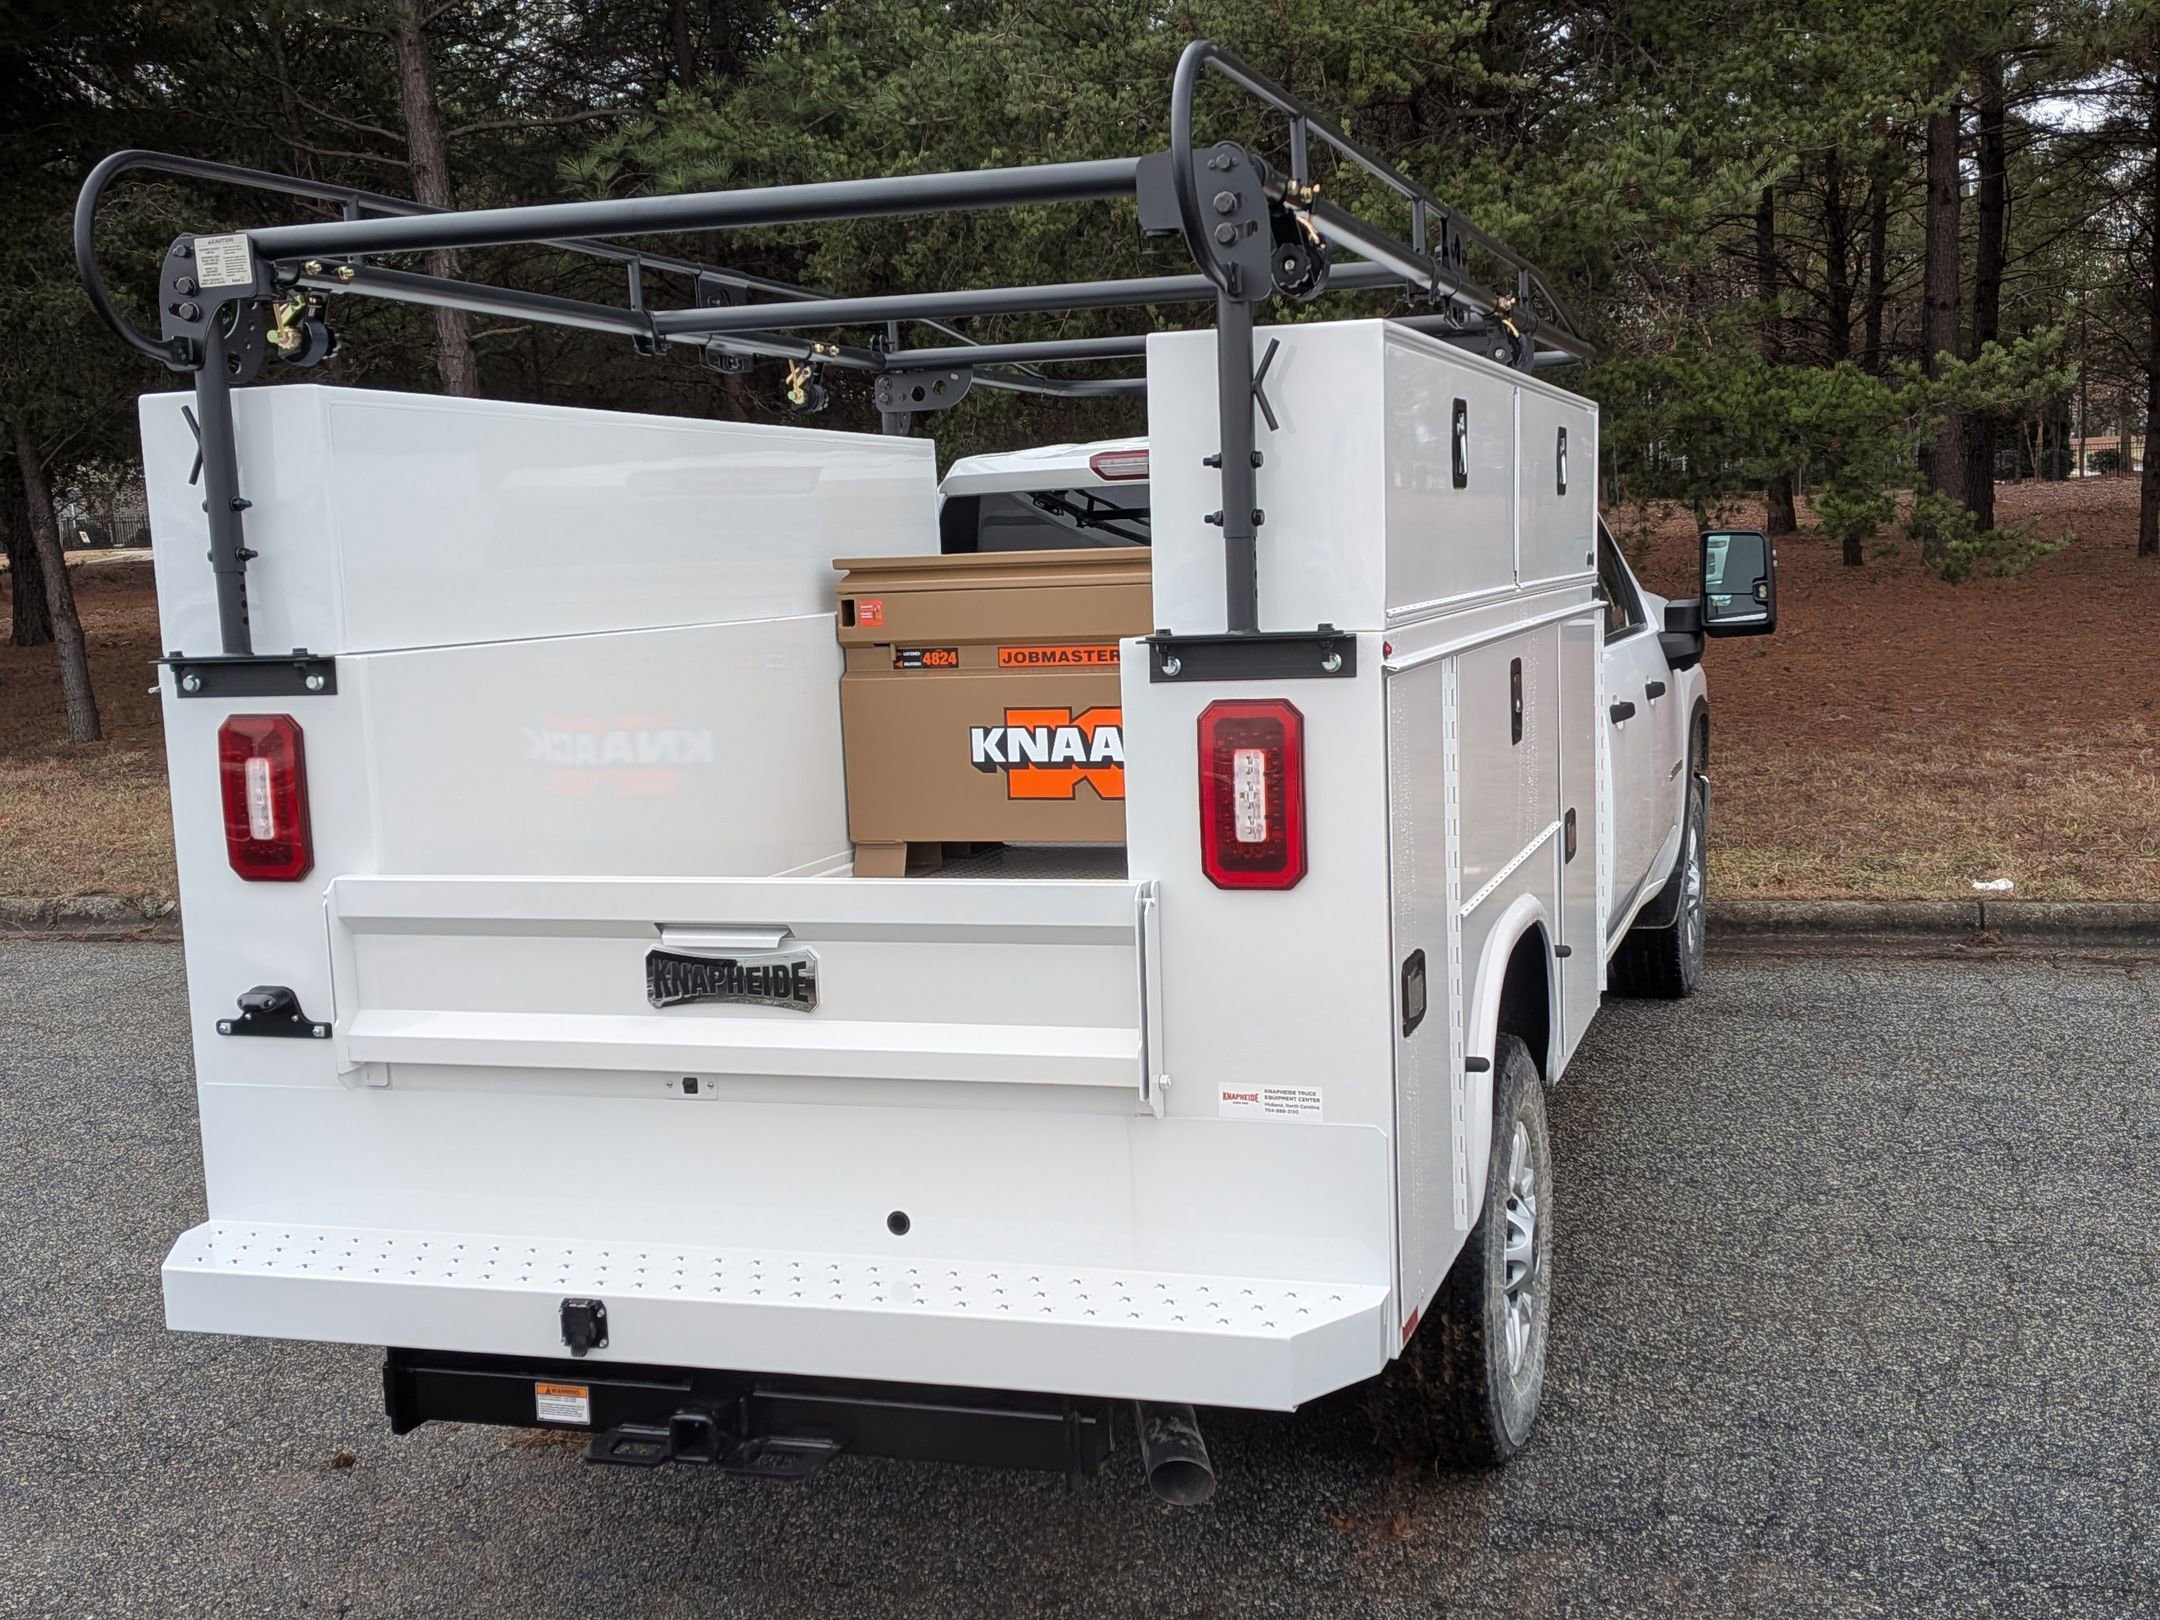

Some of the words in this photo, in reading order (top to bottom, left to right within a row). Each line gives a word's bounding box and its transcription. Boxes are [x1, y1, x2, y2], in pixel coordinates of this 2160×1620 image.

[923, 651, 957, 665] 4824
[1002, 649, 1120, 664] JOBMASTER
[970, 725, 1125, 767] KNAA
[652, 958, 809, 1002] KNAPHEIDE
[1223, 1091, 1259, 1103] KNAPHEIDE
